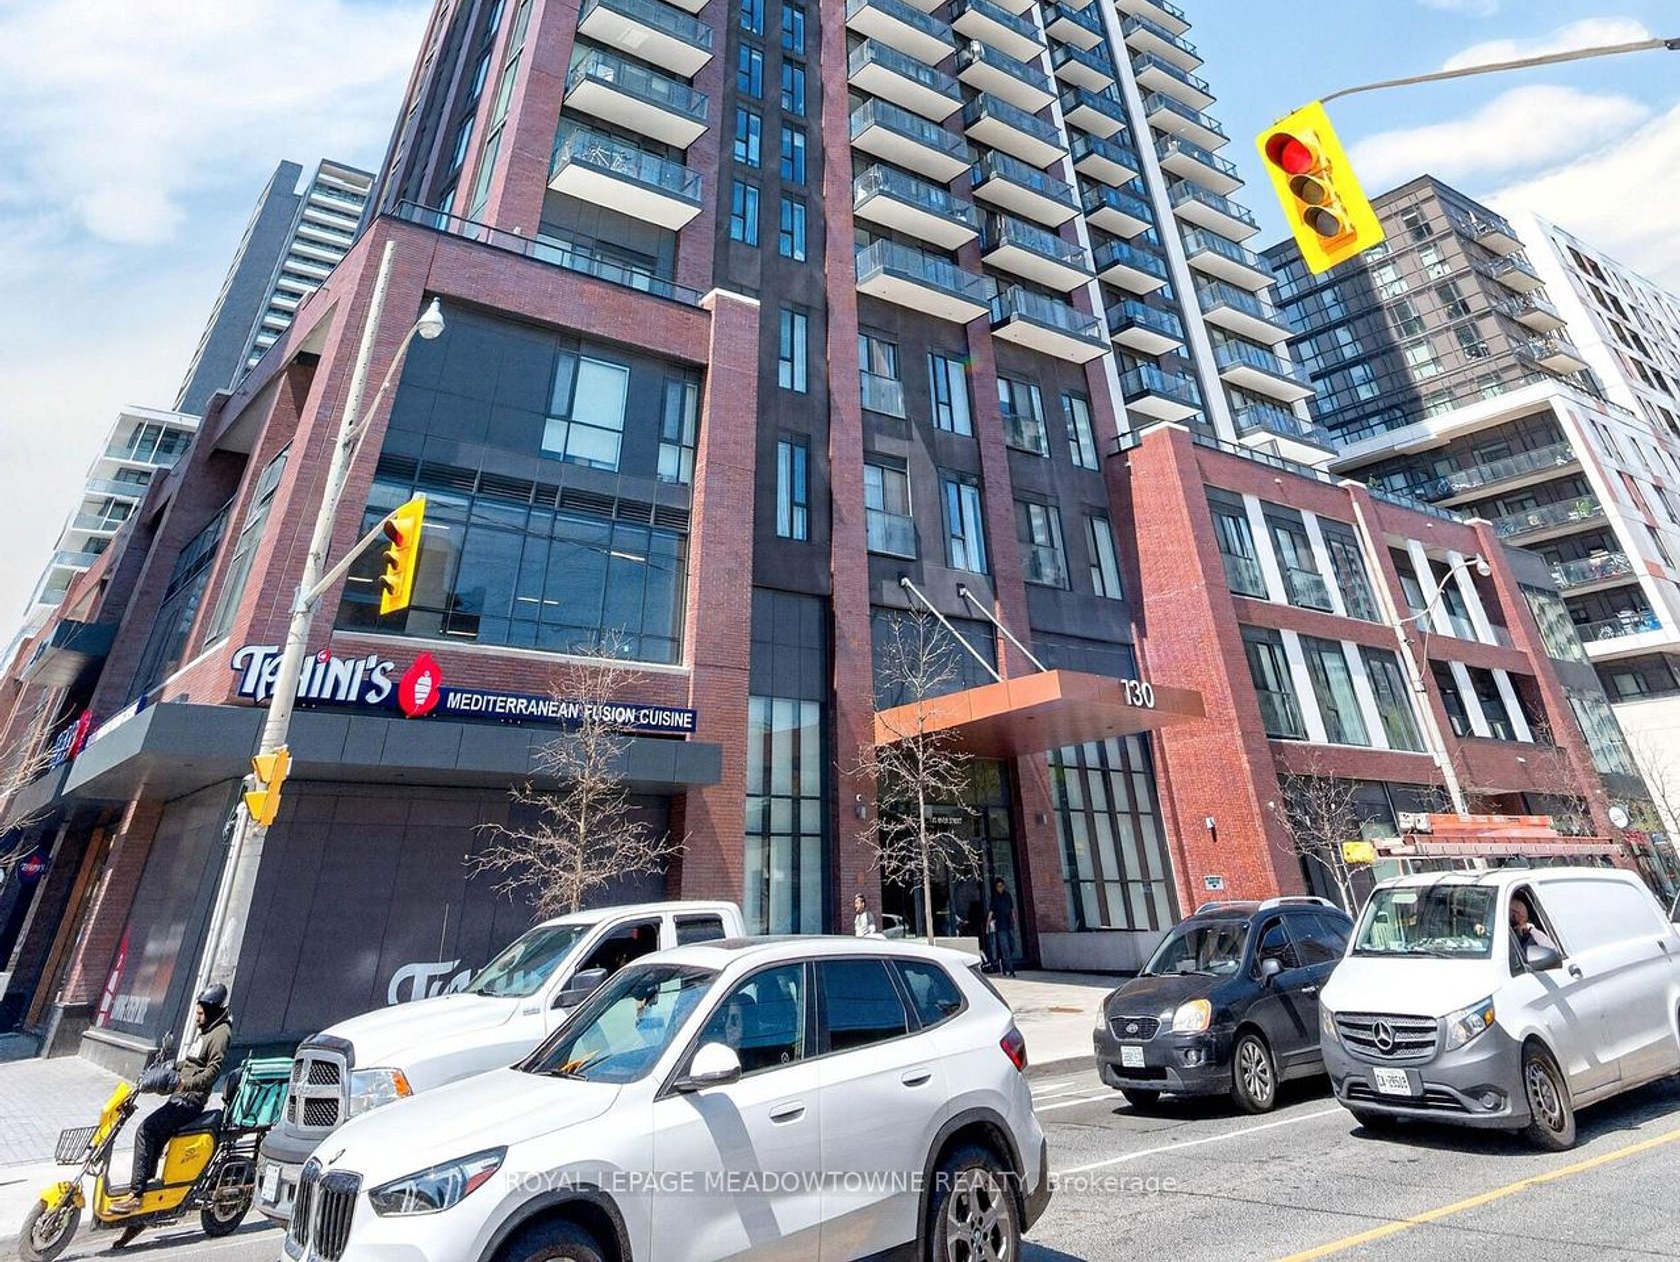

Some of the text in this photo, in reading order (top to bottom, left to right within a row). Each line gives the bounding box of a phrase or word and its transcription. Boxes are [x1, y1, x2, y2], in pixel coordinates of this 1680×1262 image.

[446, 692, 693, 728] MEDITERRANEAN FUSION CUISINE
